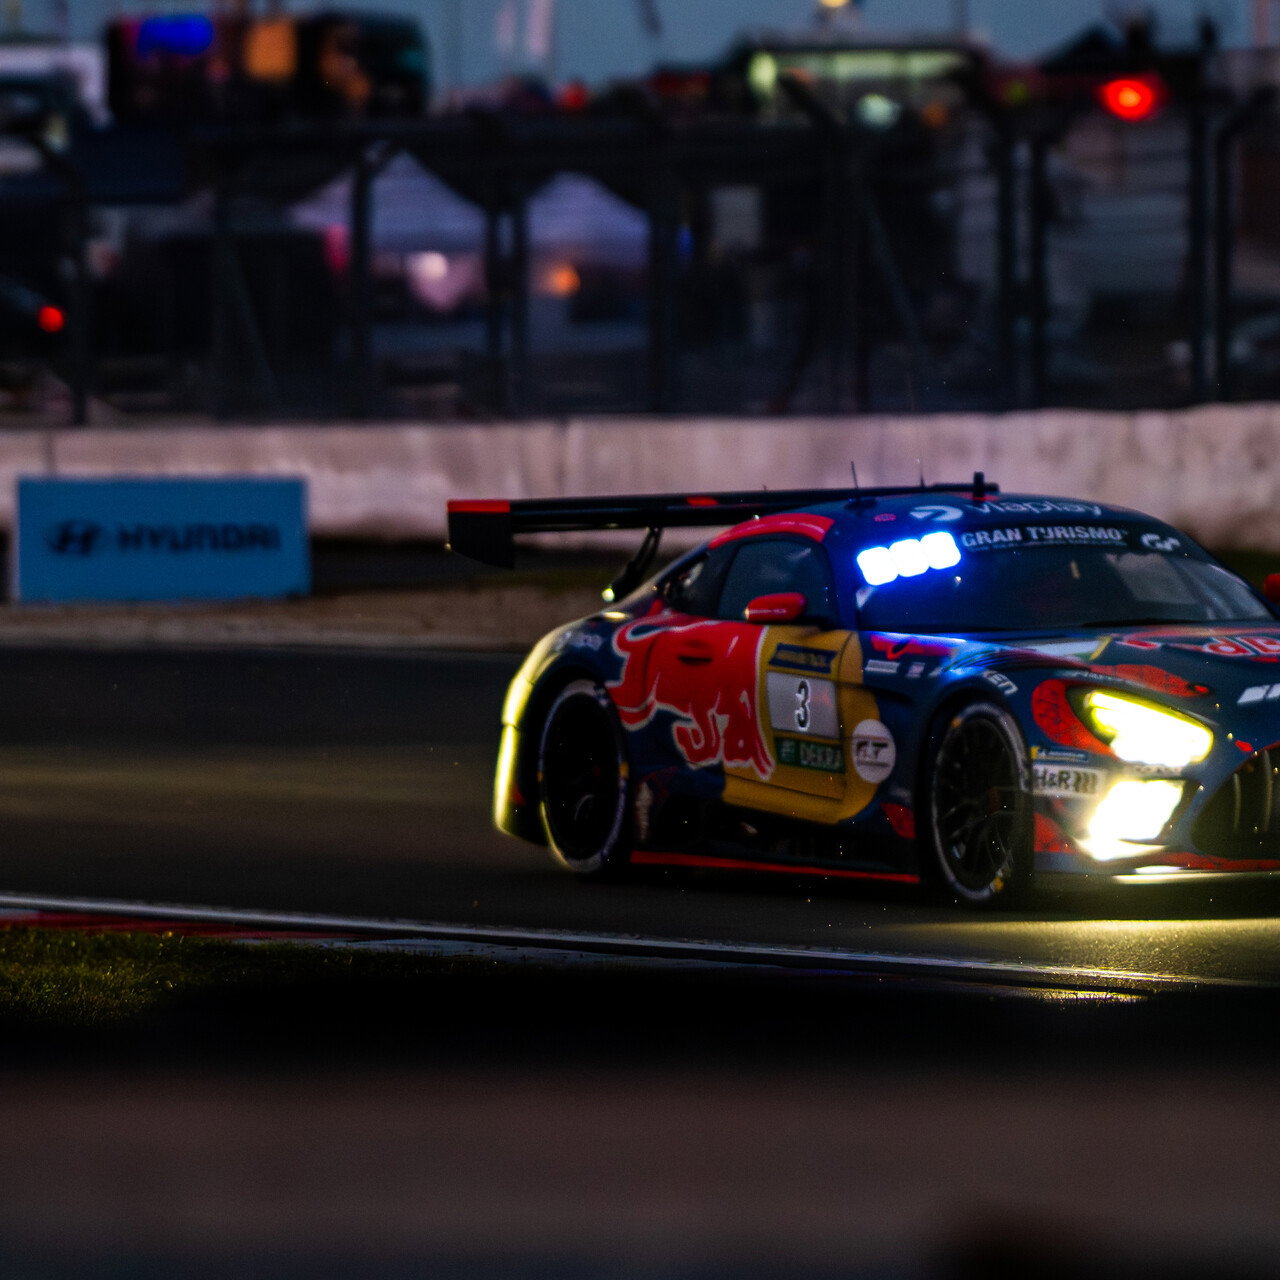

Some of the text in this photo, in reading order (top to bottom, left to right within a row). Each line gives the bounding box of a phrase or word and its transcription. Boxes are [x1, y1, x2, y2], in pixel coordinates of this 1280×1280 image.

[116, 524, 281, 550] HYUNDAI
[960, 527, 1021, 548] GRAN
[1026, 525, 1123, 541] TURISMO
[794, 679, 811, 732] 3
[1033, 767, 1071, 790] H&R
